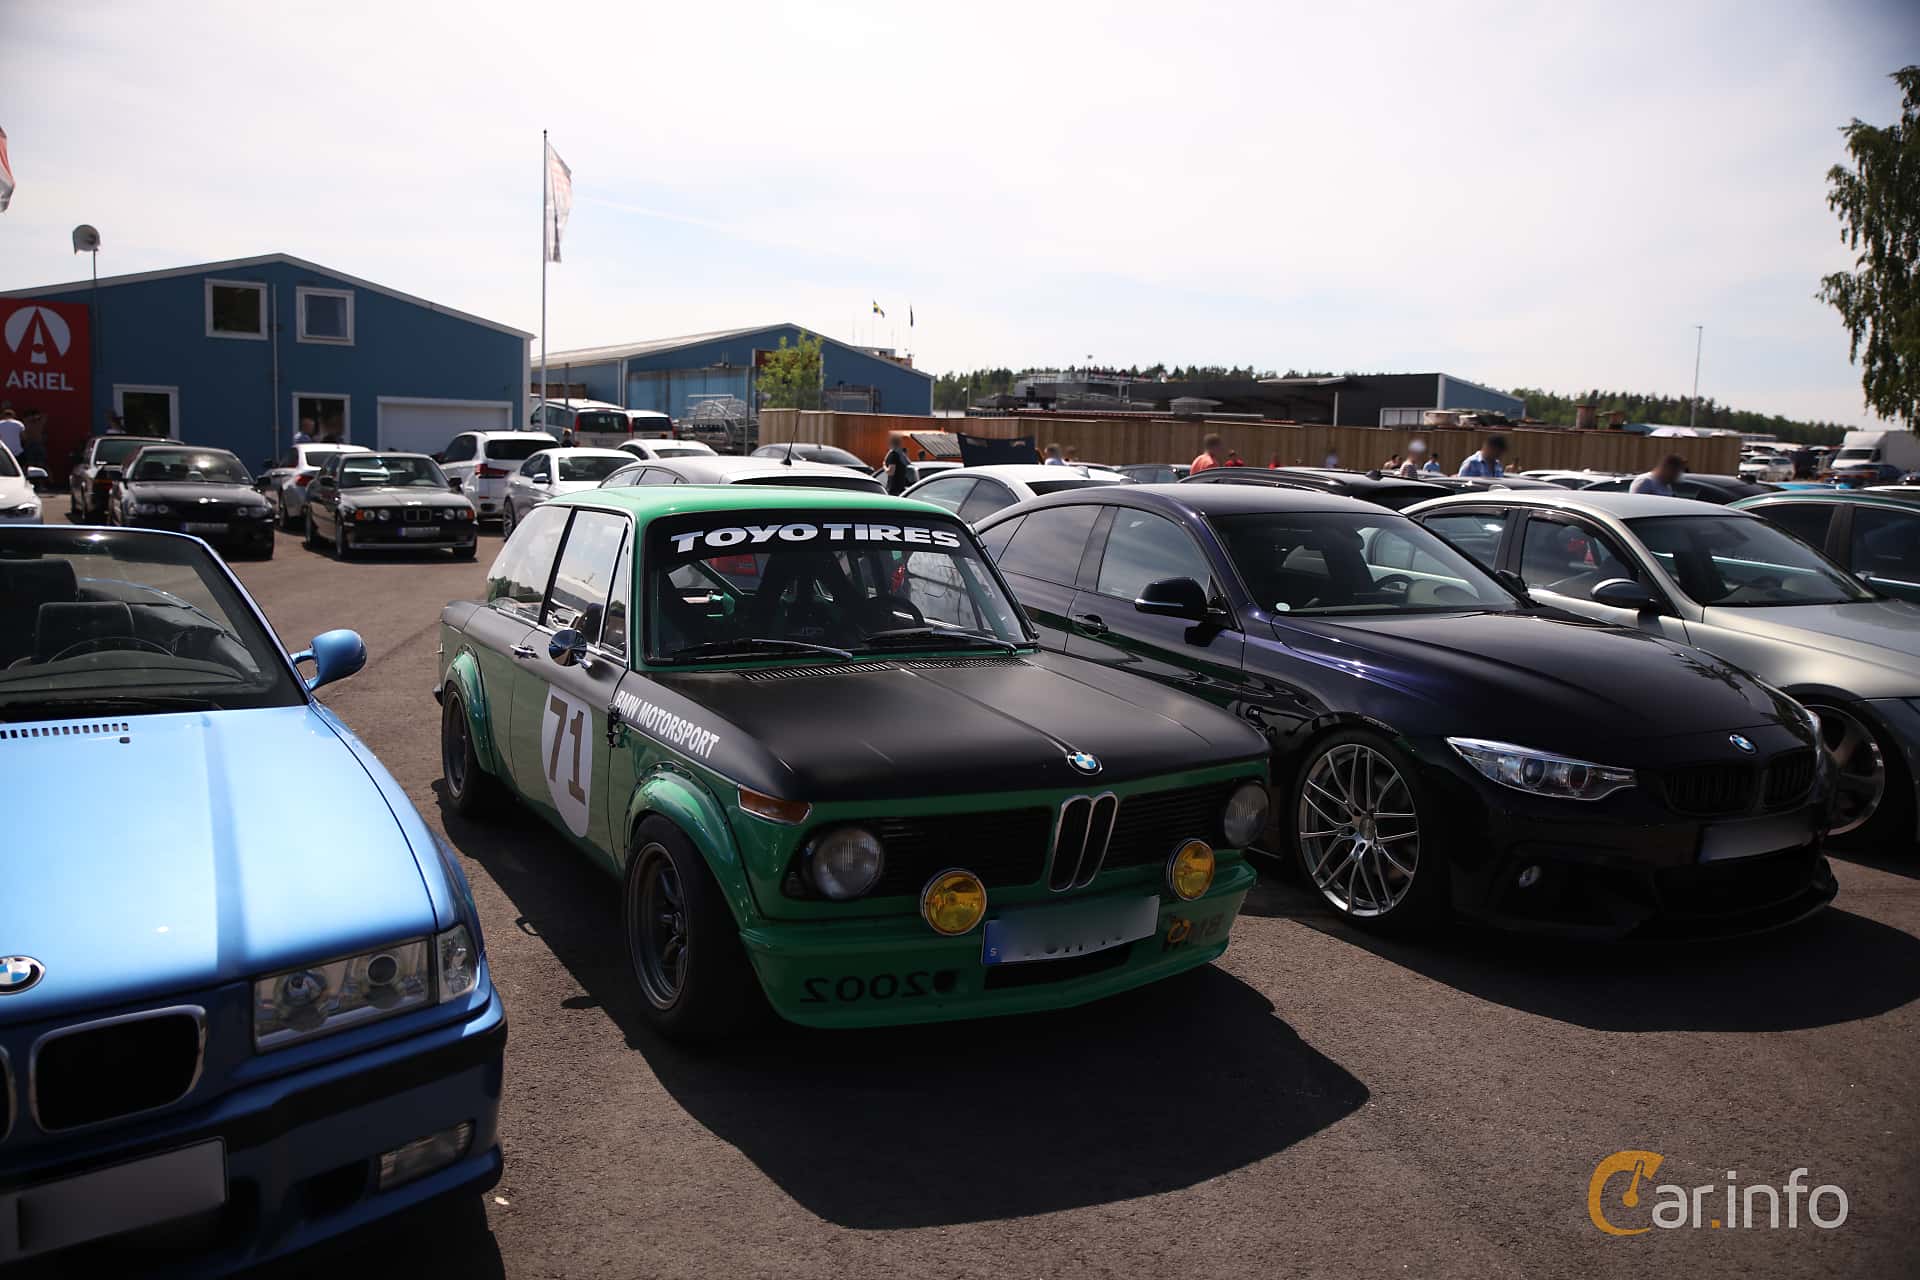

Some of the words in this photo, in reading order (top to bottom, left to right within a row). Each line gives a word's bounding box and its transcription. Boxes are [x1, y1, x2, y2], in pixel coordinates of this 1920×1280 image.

[5, 369, 76, 391] ARIEL
[670, 523, 819, 553] TOYO
[823, 523, 961, 548] TIRES
[615, 690, 642, 720] BMW
[637, 701, 721, 759] MOTORSPORT
[549, 694, 587, 806] 71
